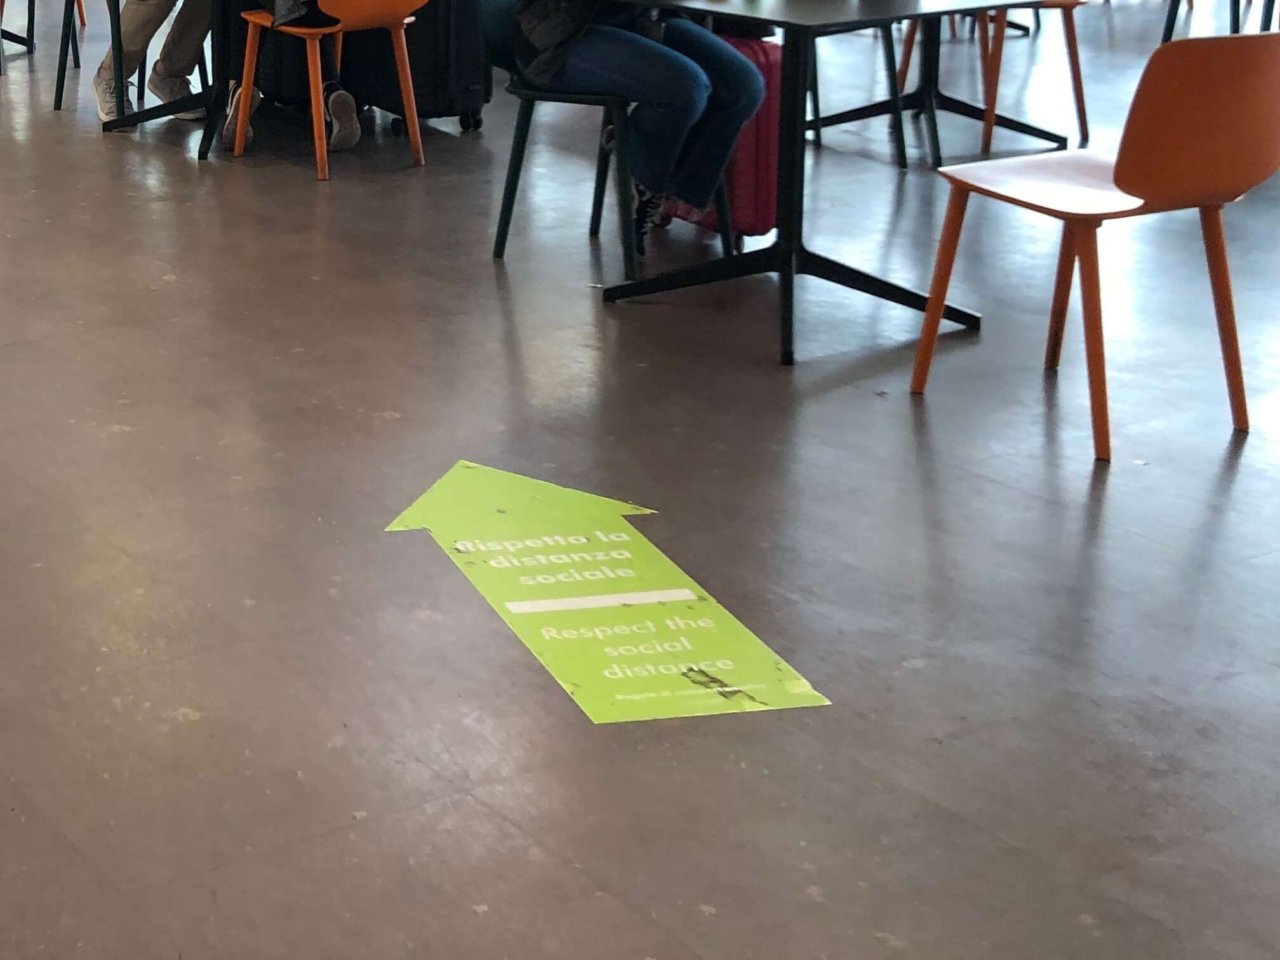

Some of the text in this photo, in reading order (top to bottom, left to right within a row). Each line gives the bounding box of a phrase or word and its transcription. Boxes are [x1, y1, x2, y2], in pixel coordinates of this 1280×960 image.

[455, 530, 631, 553] Rispetta la
[488, 548, 632, 569] distanza
[518, 565, 637, 586] sociale
[540, 616, 716, 640] Respect the
[604, 636, 693, 657] social
[603, 658, 734, 679] distance
